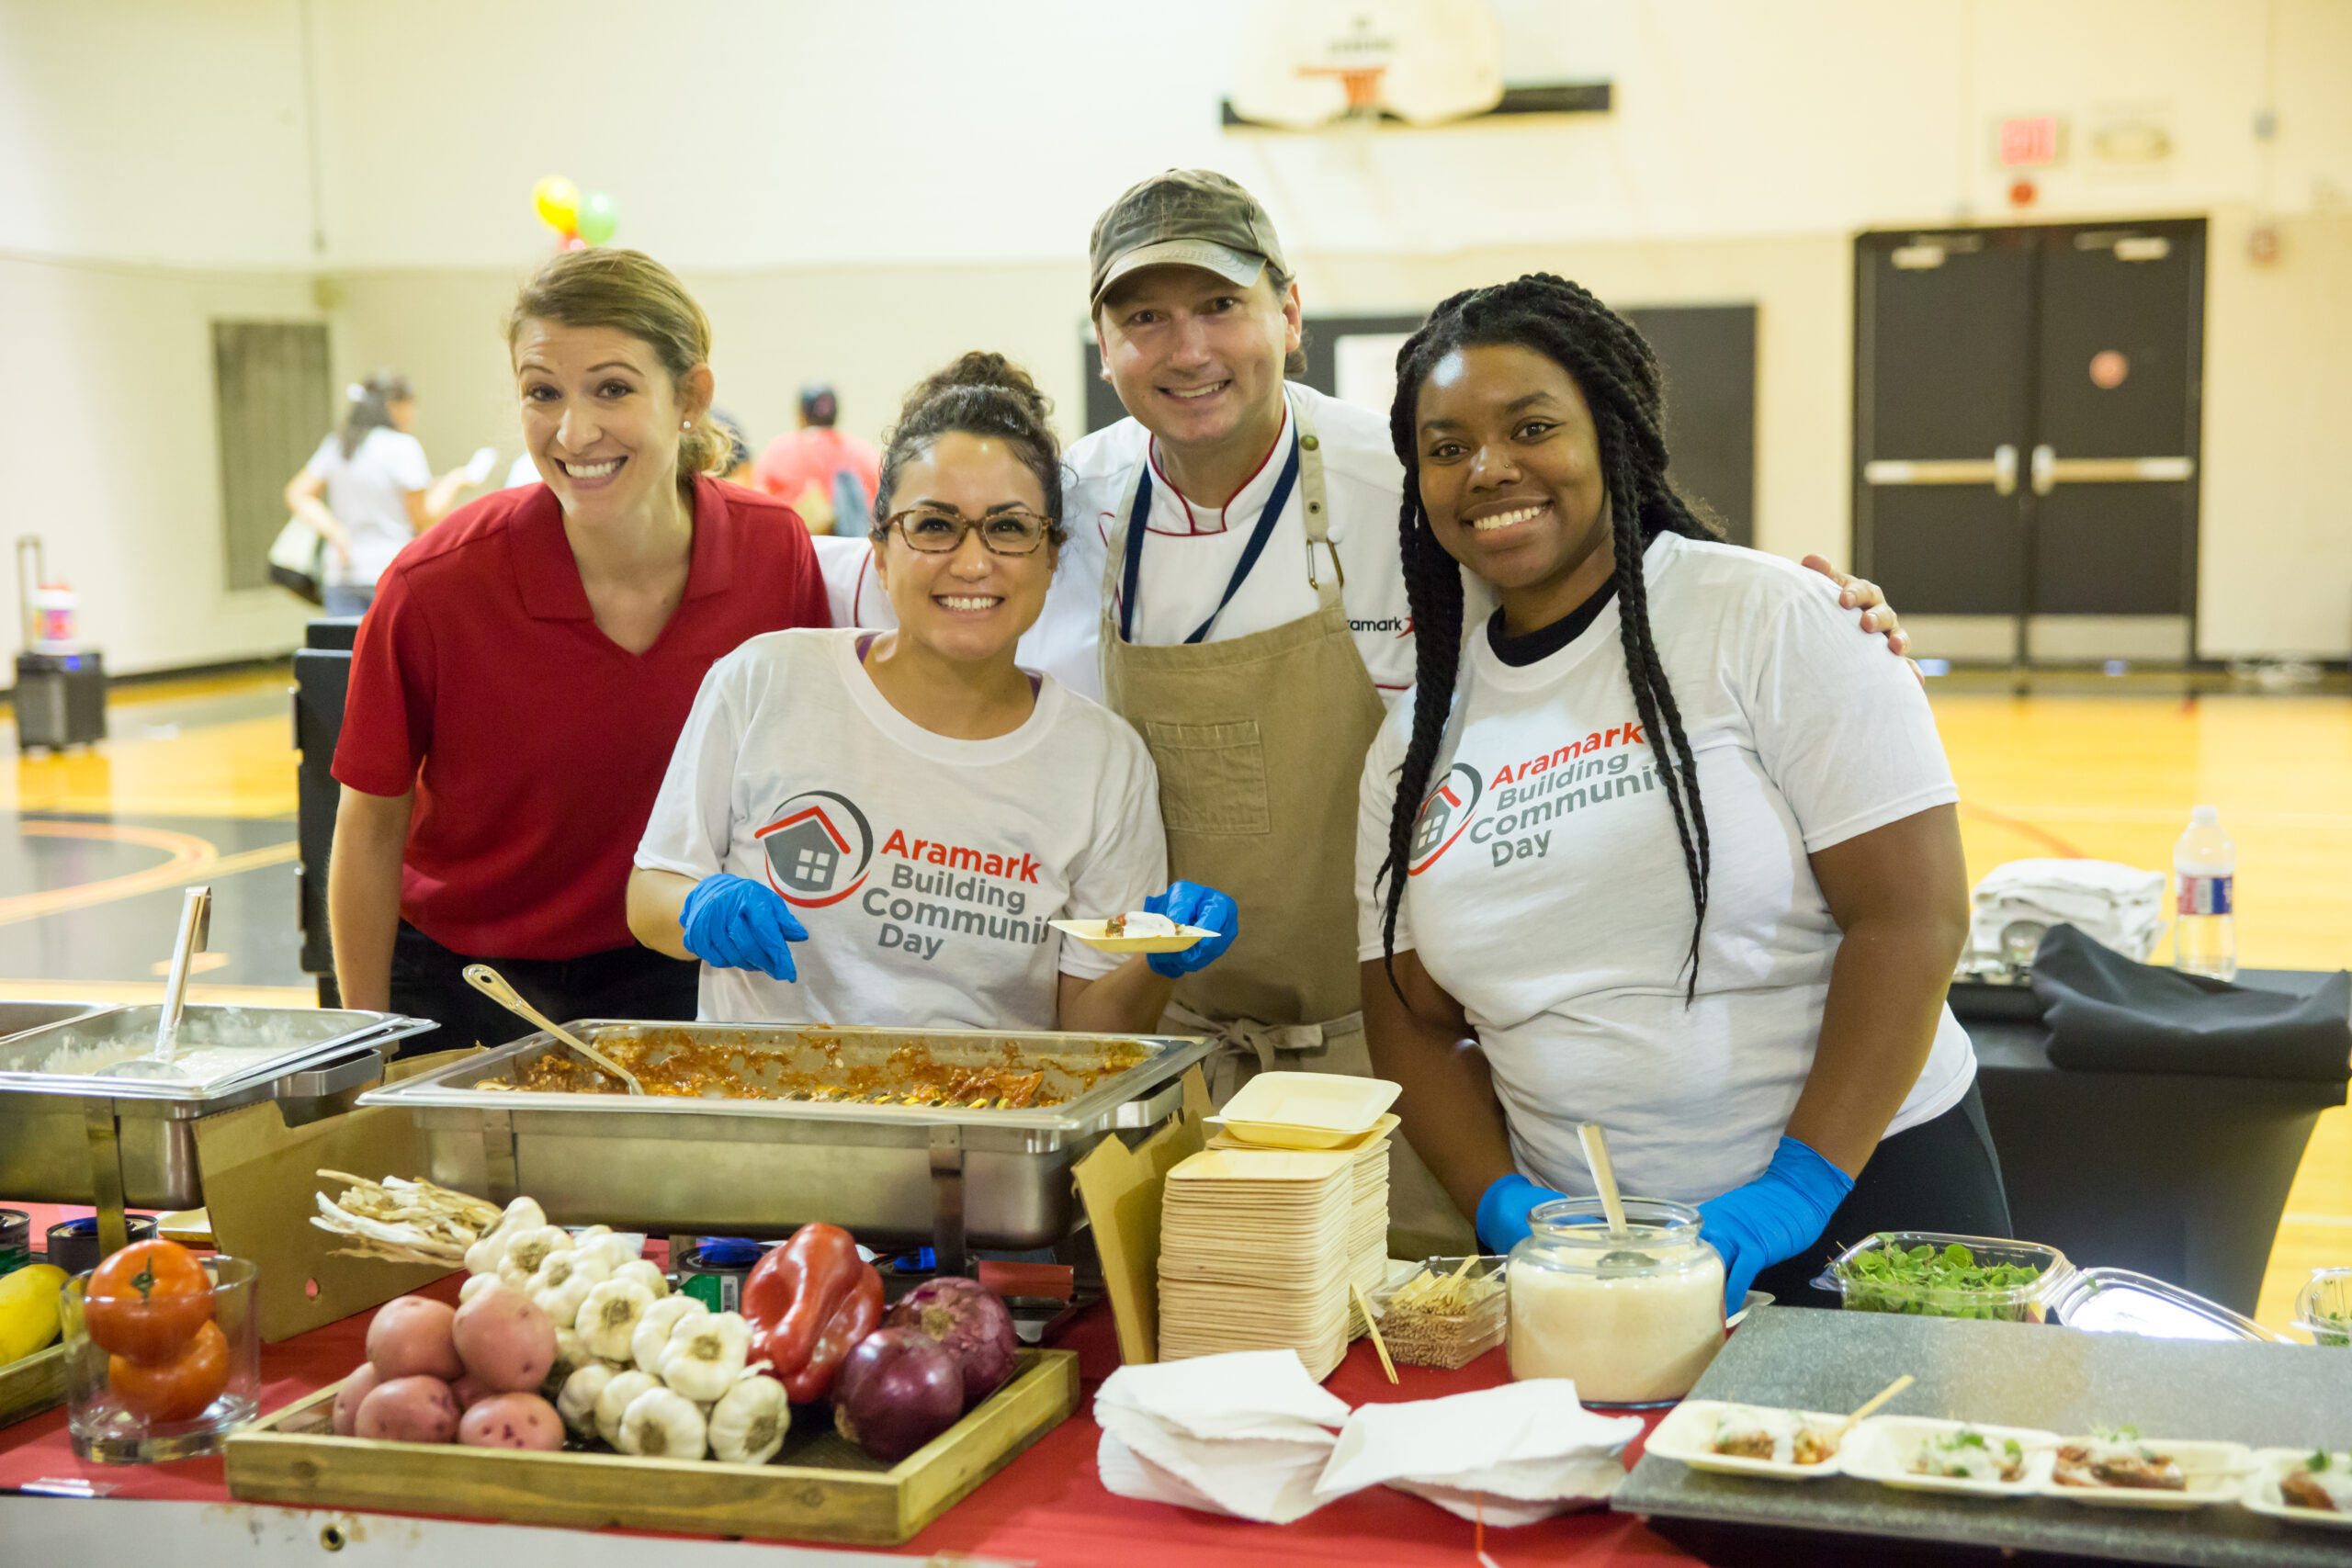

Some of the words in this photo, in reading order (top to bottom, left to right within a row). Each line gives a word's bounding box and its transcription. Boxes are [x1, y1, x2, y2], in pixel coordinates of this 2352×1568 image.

[1488, 722, 1645, 791] Aramark
[1496, 753, 1629, 812] Building
[1469, 761, 1698, 845] Communi
[880, 829, 1042, 884] Aramark
[1491, 829, 1552, 868] Day
[891, 863, 1026, 915] Building
[877, 922, 944, 961] Day
